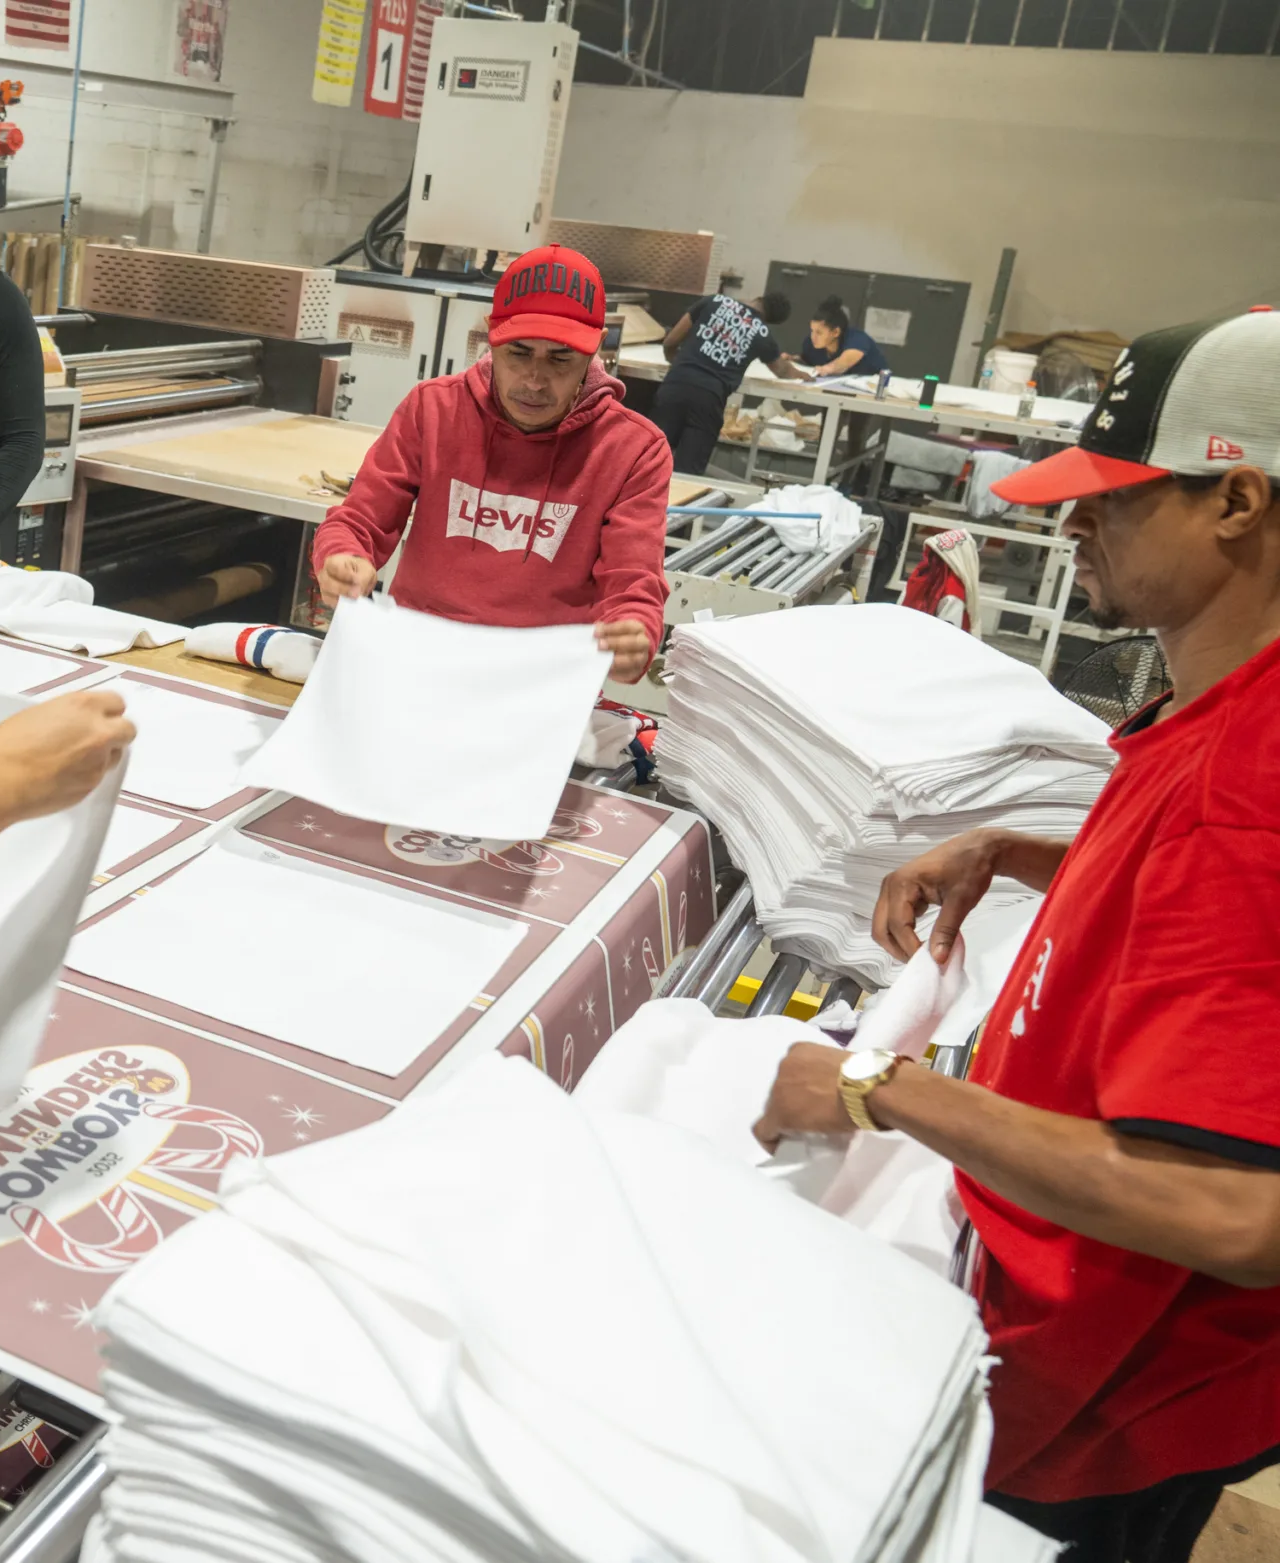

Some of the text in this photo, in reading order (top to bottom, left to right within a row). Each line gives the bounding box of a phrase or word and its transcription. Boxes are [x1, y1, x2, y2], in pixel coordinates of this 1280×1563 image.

[503, 262, 596, 315] JORDAN
[707, 313, 752, 352] TRYING
[715, 304, 758, 340] BROKE
[751, 317, 769, 337] GO
[696, 324, 747, 365] TO LOOK
[700, 340, 730, 367] RICH
